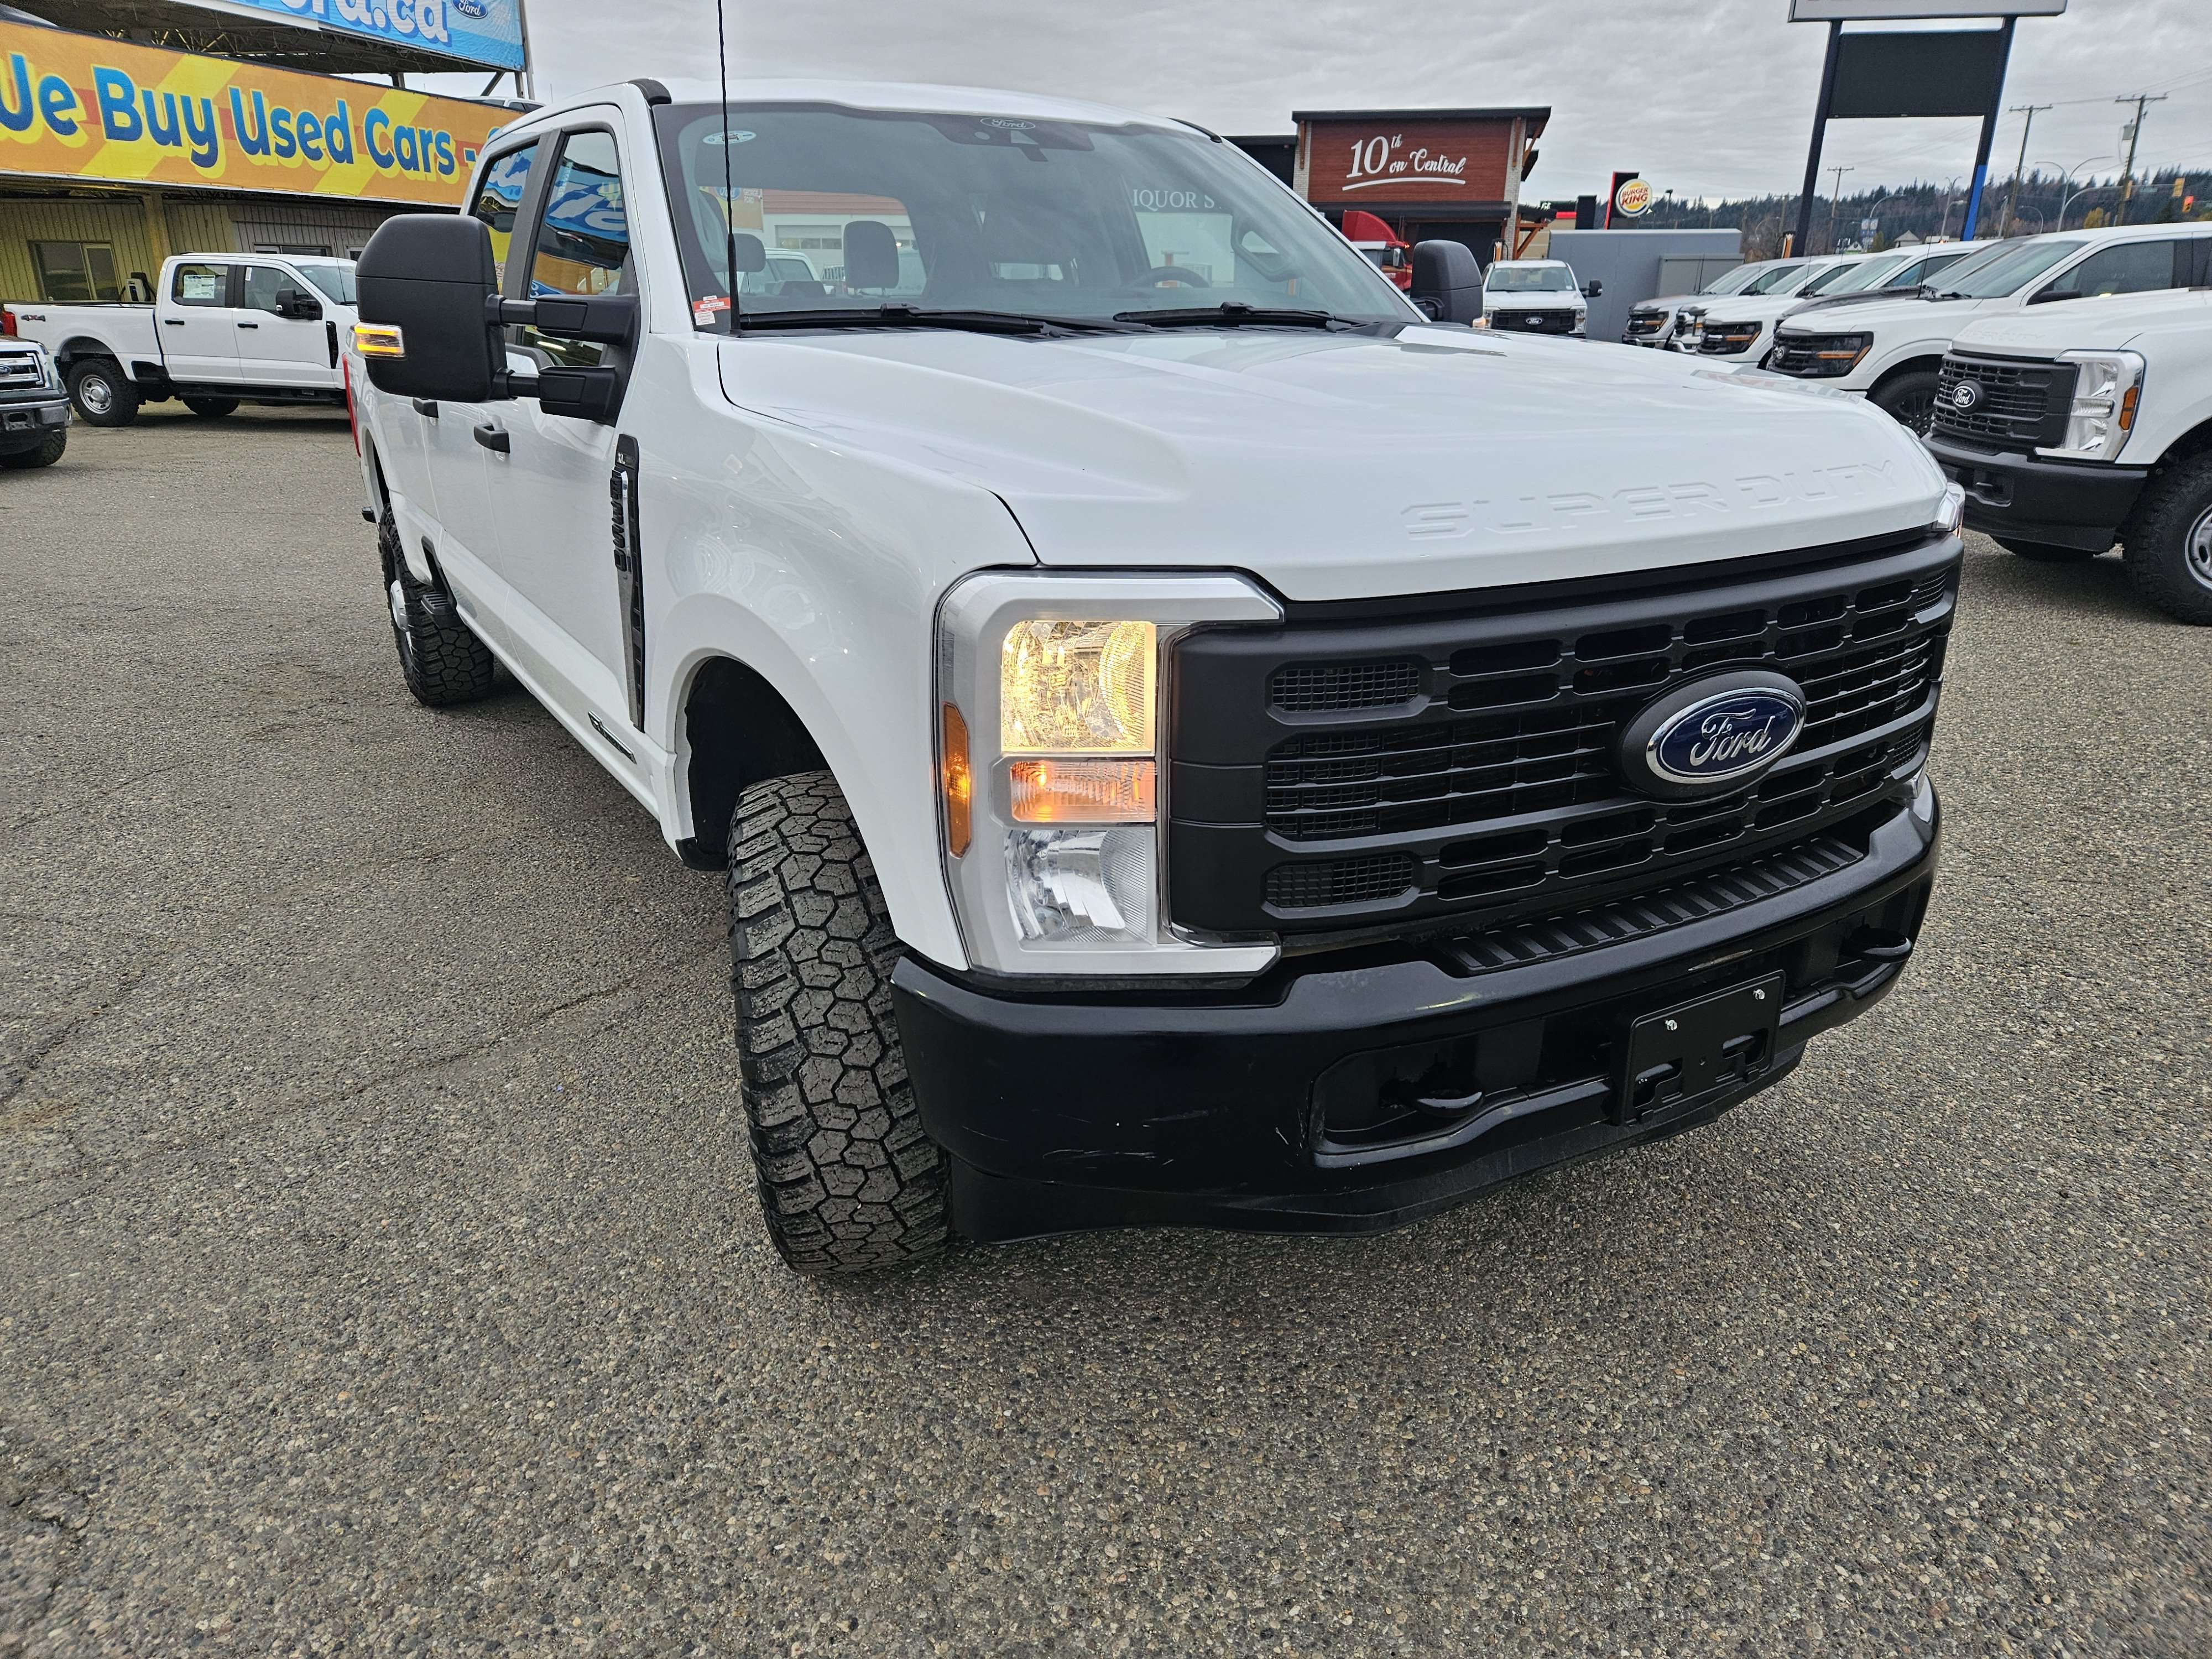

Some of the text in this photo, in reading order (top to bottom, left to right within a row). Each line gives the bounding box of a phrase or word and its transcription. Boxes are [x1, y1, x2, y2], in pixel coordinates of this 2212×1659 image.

[458, 0, 482, 15] Ford
[92, 66, 218, 168] Buy
[228, 85, 354, 164] Used
[364, 108, 455, 175] Cars
[992, 118, 1027, 128] Ford
[1389, 160, 1407, 173] on
[1409, 148, 1467, 174] Central
[1133, 189, 1199, 212] IQUOR
[1621, 187, 1648, 197] BURGER
[1621, 194, 1647, 206] KING
[1955, 388, 1971, 405] Ford
[617, 452, 625, 465] XL
[1400, 458, 1897, 541] SUPER DUTY
[1689, 708, 1776, 766] Ford
